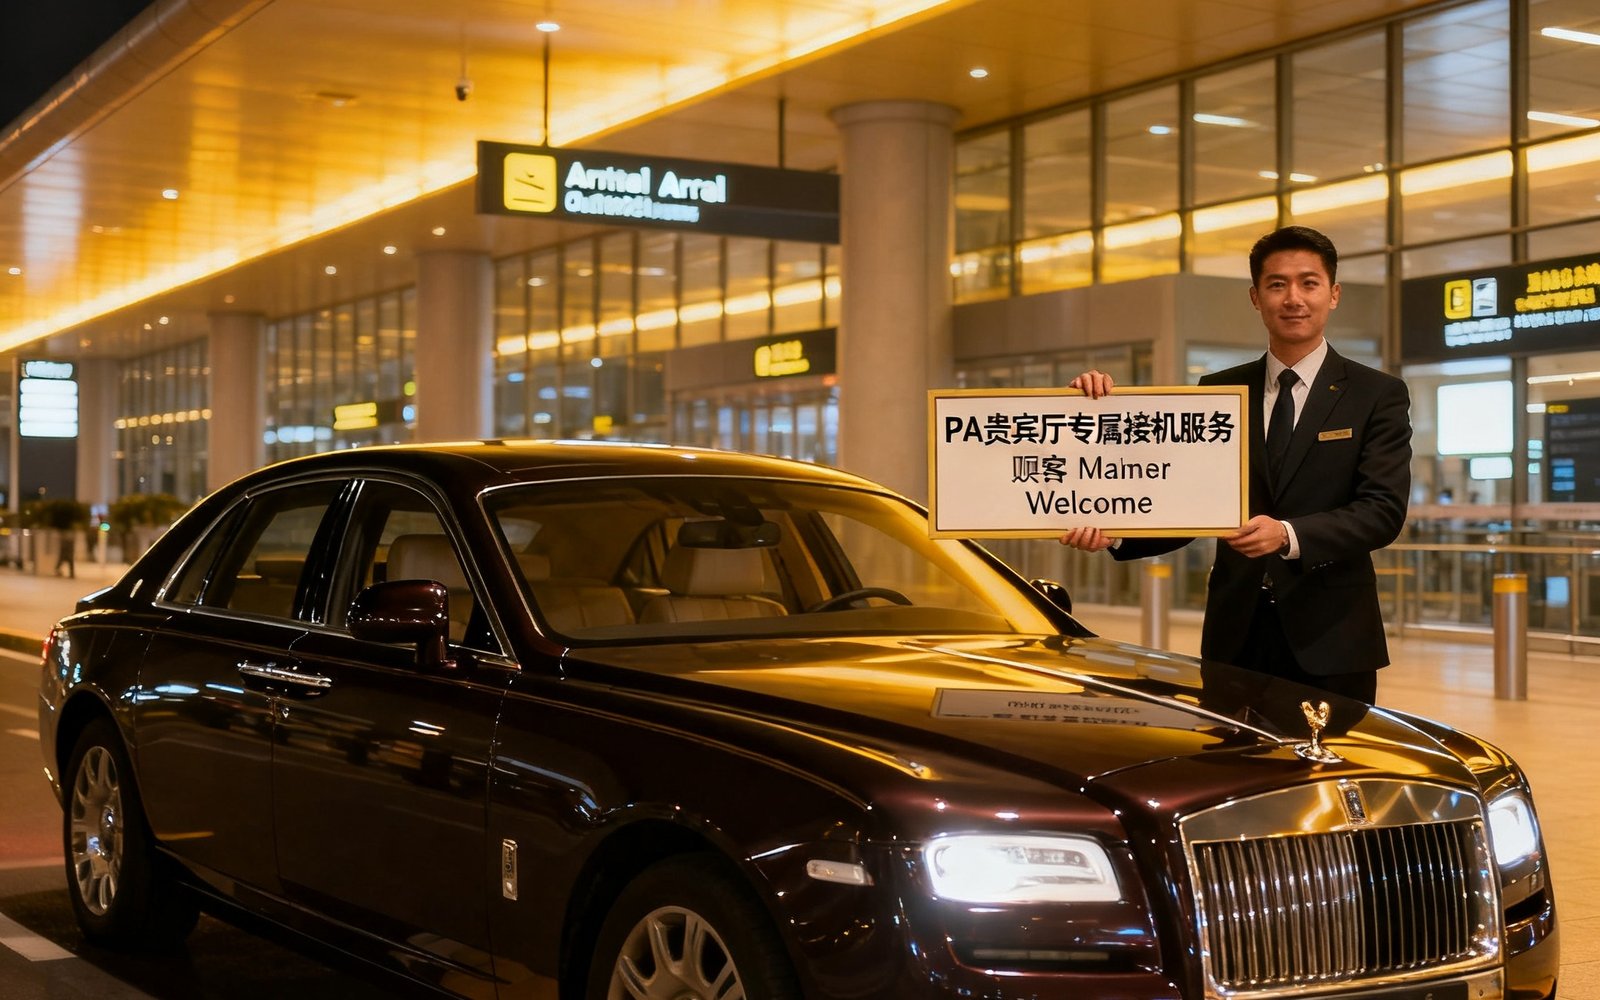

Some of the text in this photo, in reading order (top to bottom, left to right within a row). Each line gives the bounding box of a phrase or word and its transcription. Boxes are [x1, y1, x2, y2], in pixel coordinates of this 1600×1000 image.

[945, 410, 1235, 446] PA贵宾厅专属接机服务
[1025, 490, 1153, 515] Welcome
